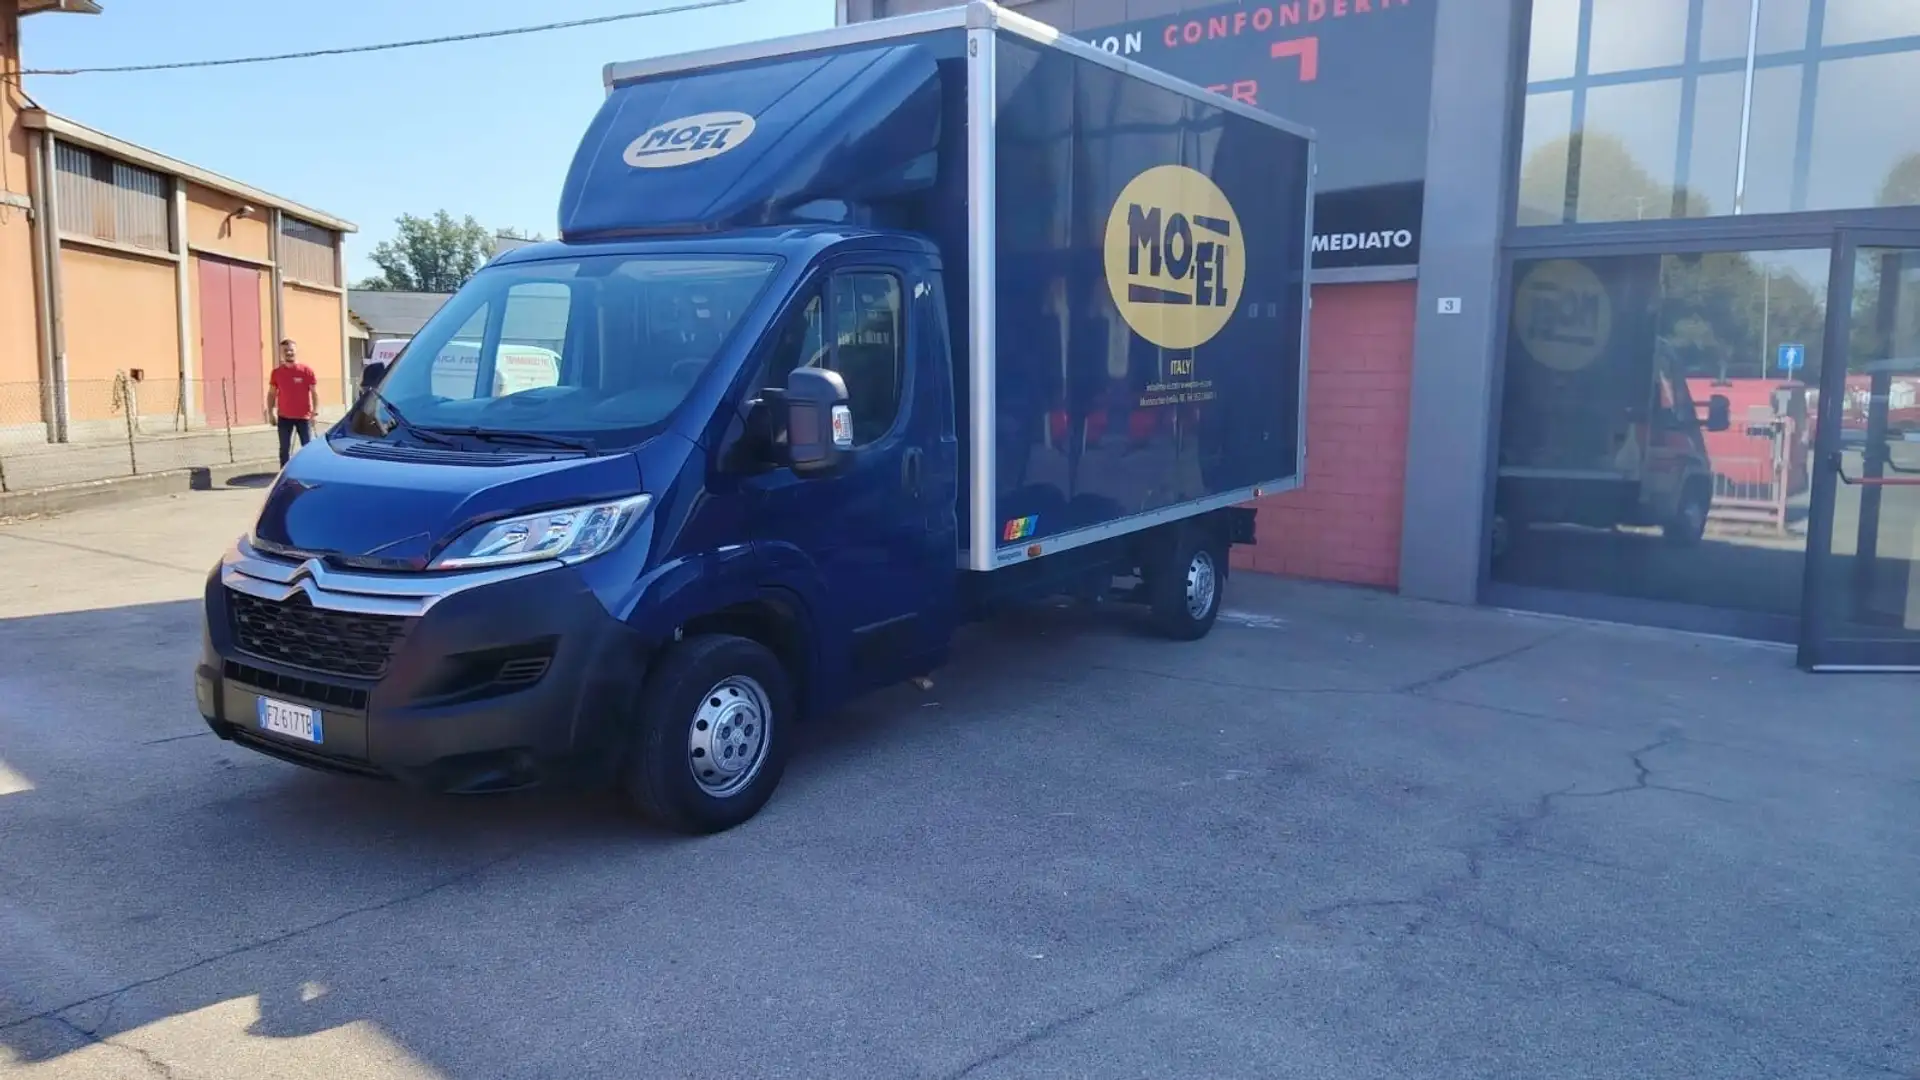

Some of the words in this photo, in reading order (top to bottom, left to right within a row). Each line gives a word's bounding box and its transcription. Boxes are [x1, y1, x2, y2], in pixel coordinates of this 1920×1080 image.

[641, 125, 731, 151] MOEL
[1127, 203, 1229, 307] MOEL
[1444, 300, 1454, 311] 3
[1170, 360, 1191, 375] ITALY
